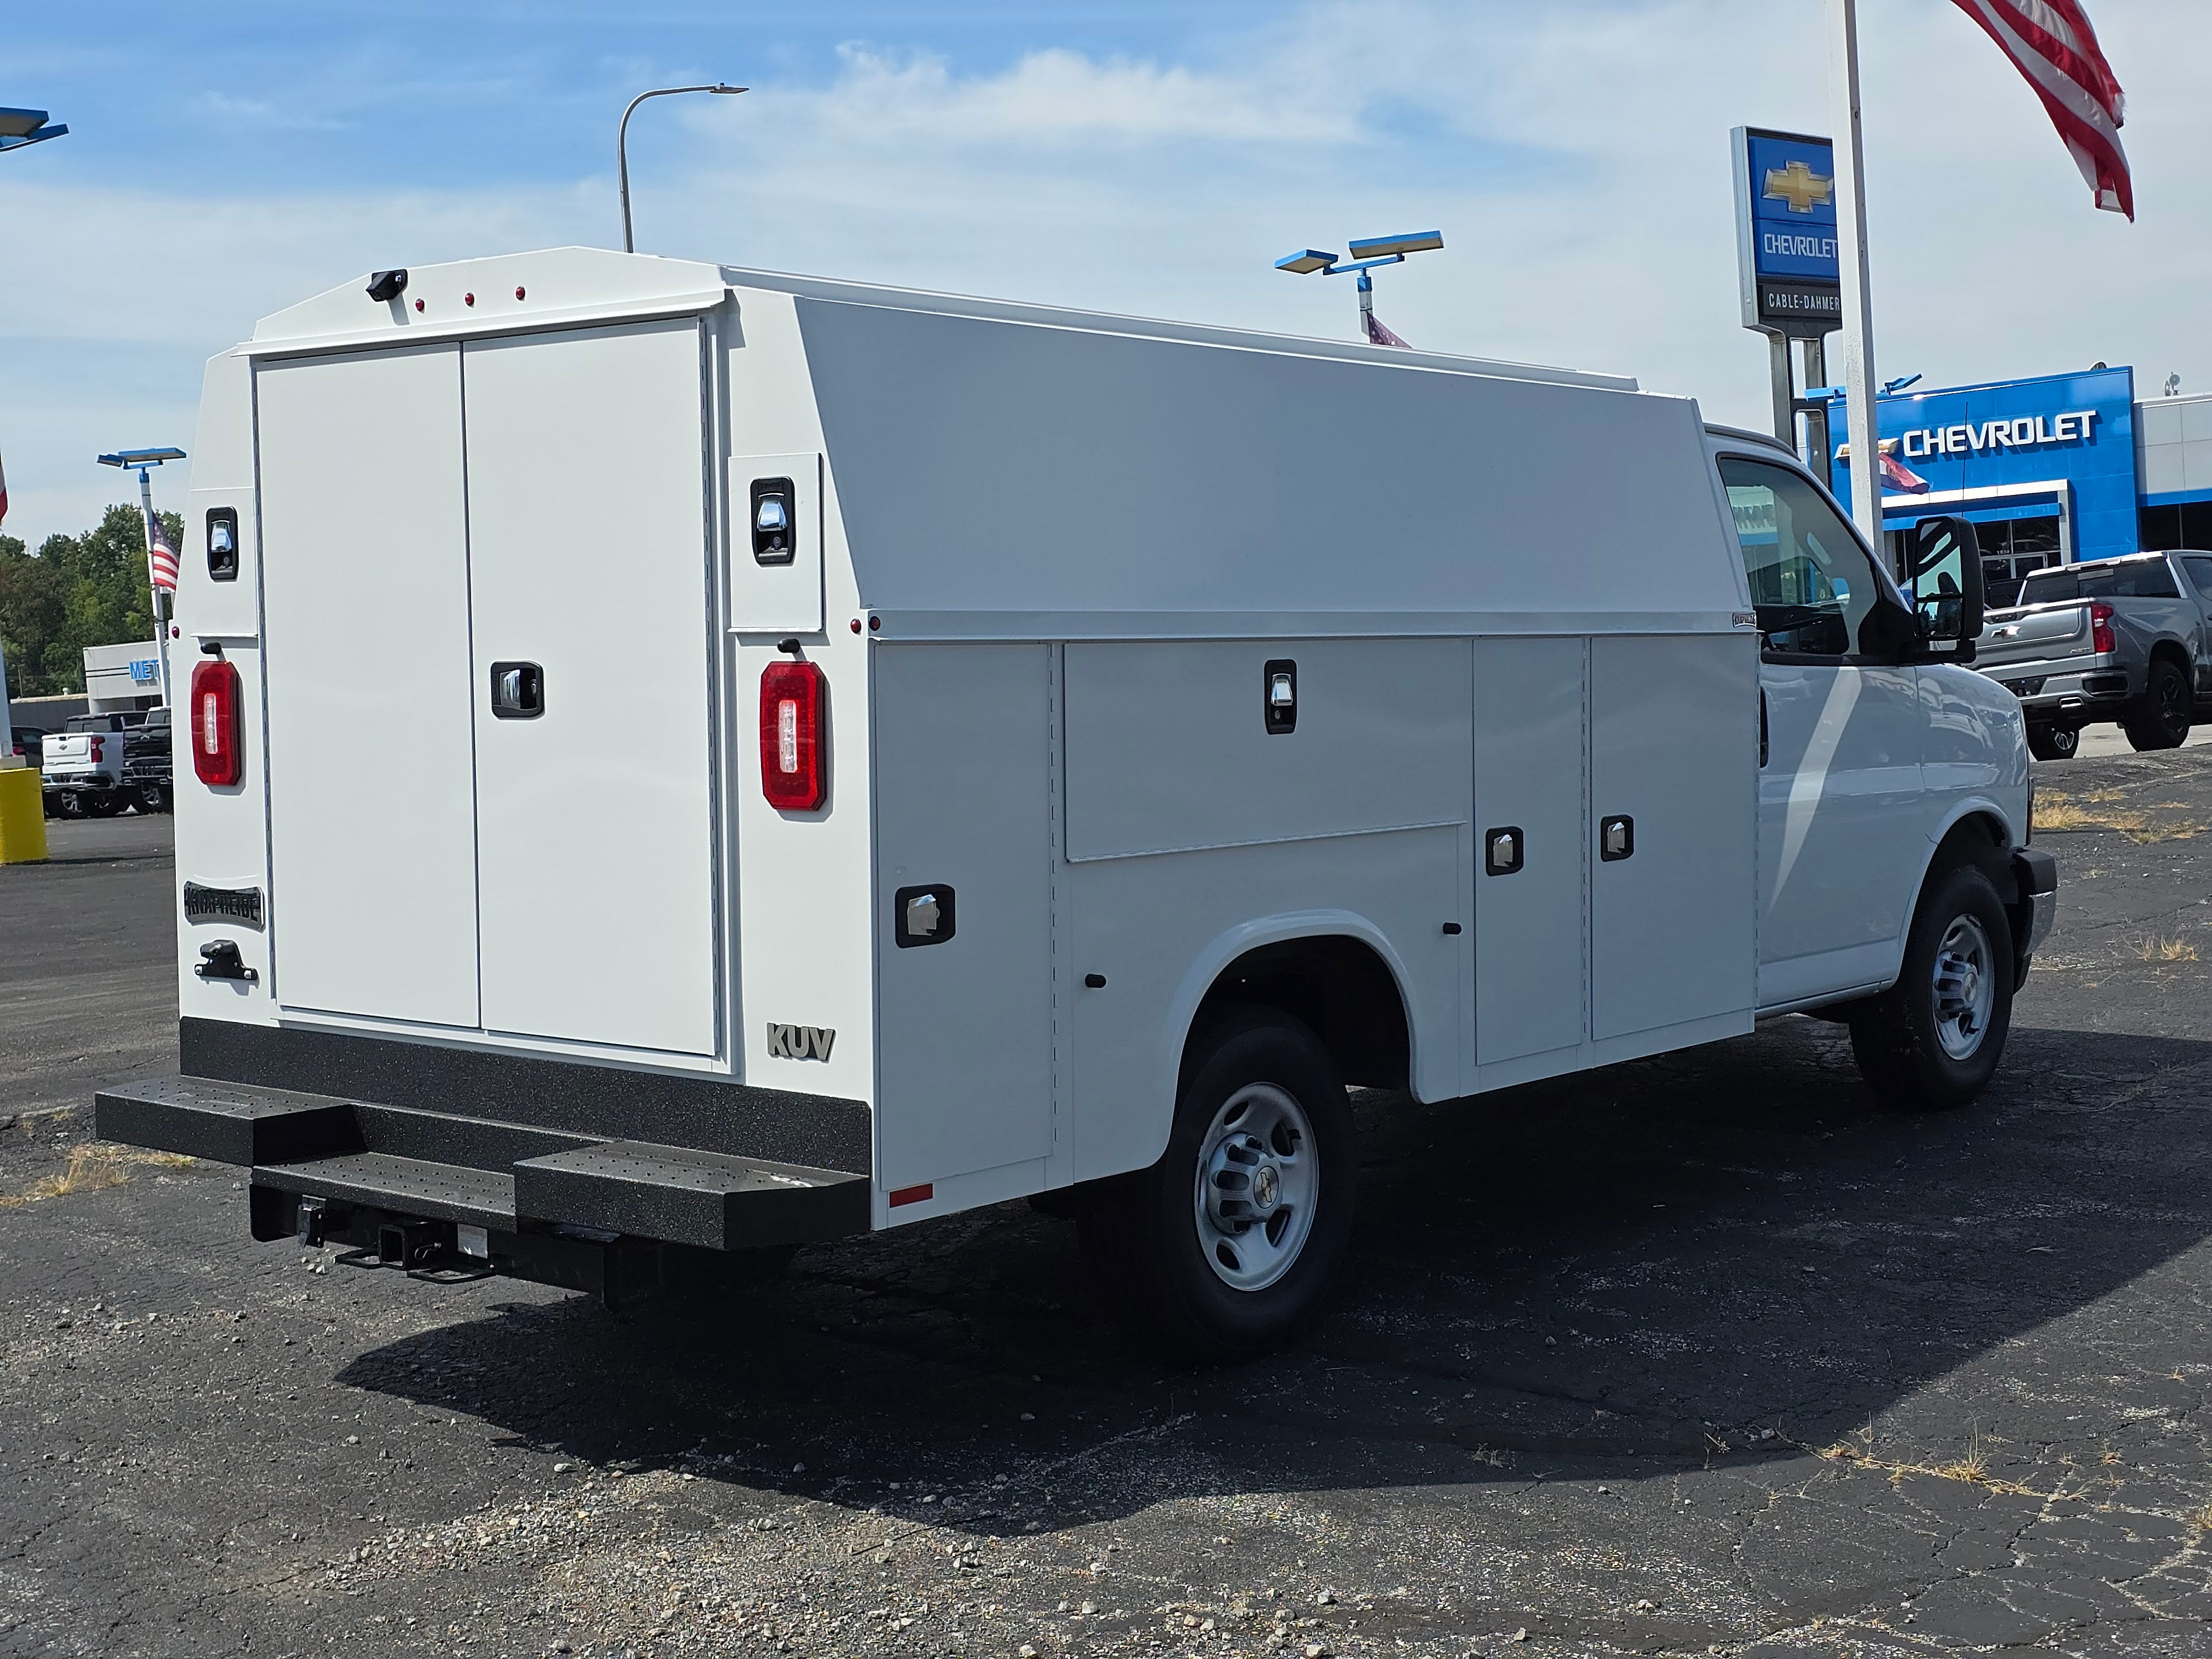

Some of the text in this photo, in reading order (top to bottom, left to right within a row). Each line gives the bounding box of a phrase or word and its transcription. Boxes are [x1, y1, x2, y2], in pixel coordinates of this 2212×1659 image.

[1764, 233, 1838, 258] CHEVROLET
[1768, 293, 1840, 311] CABLE-DAHMER
[1903, 410, 2096, 457] CHEVROLET
[767, 1022, 834, 1061] KUV
